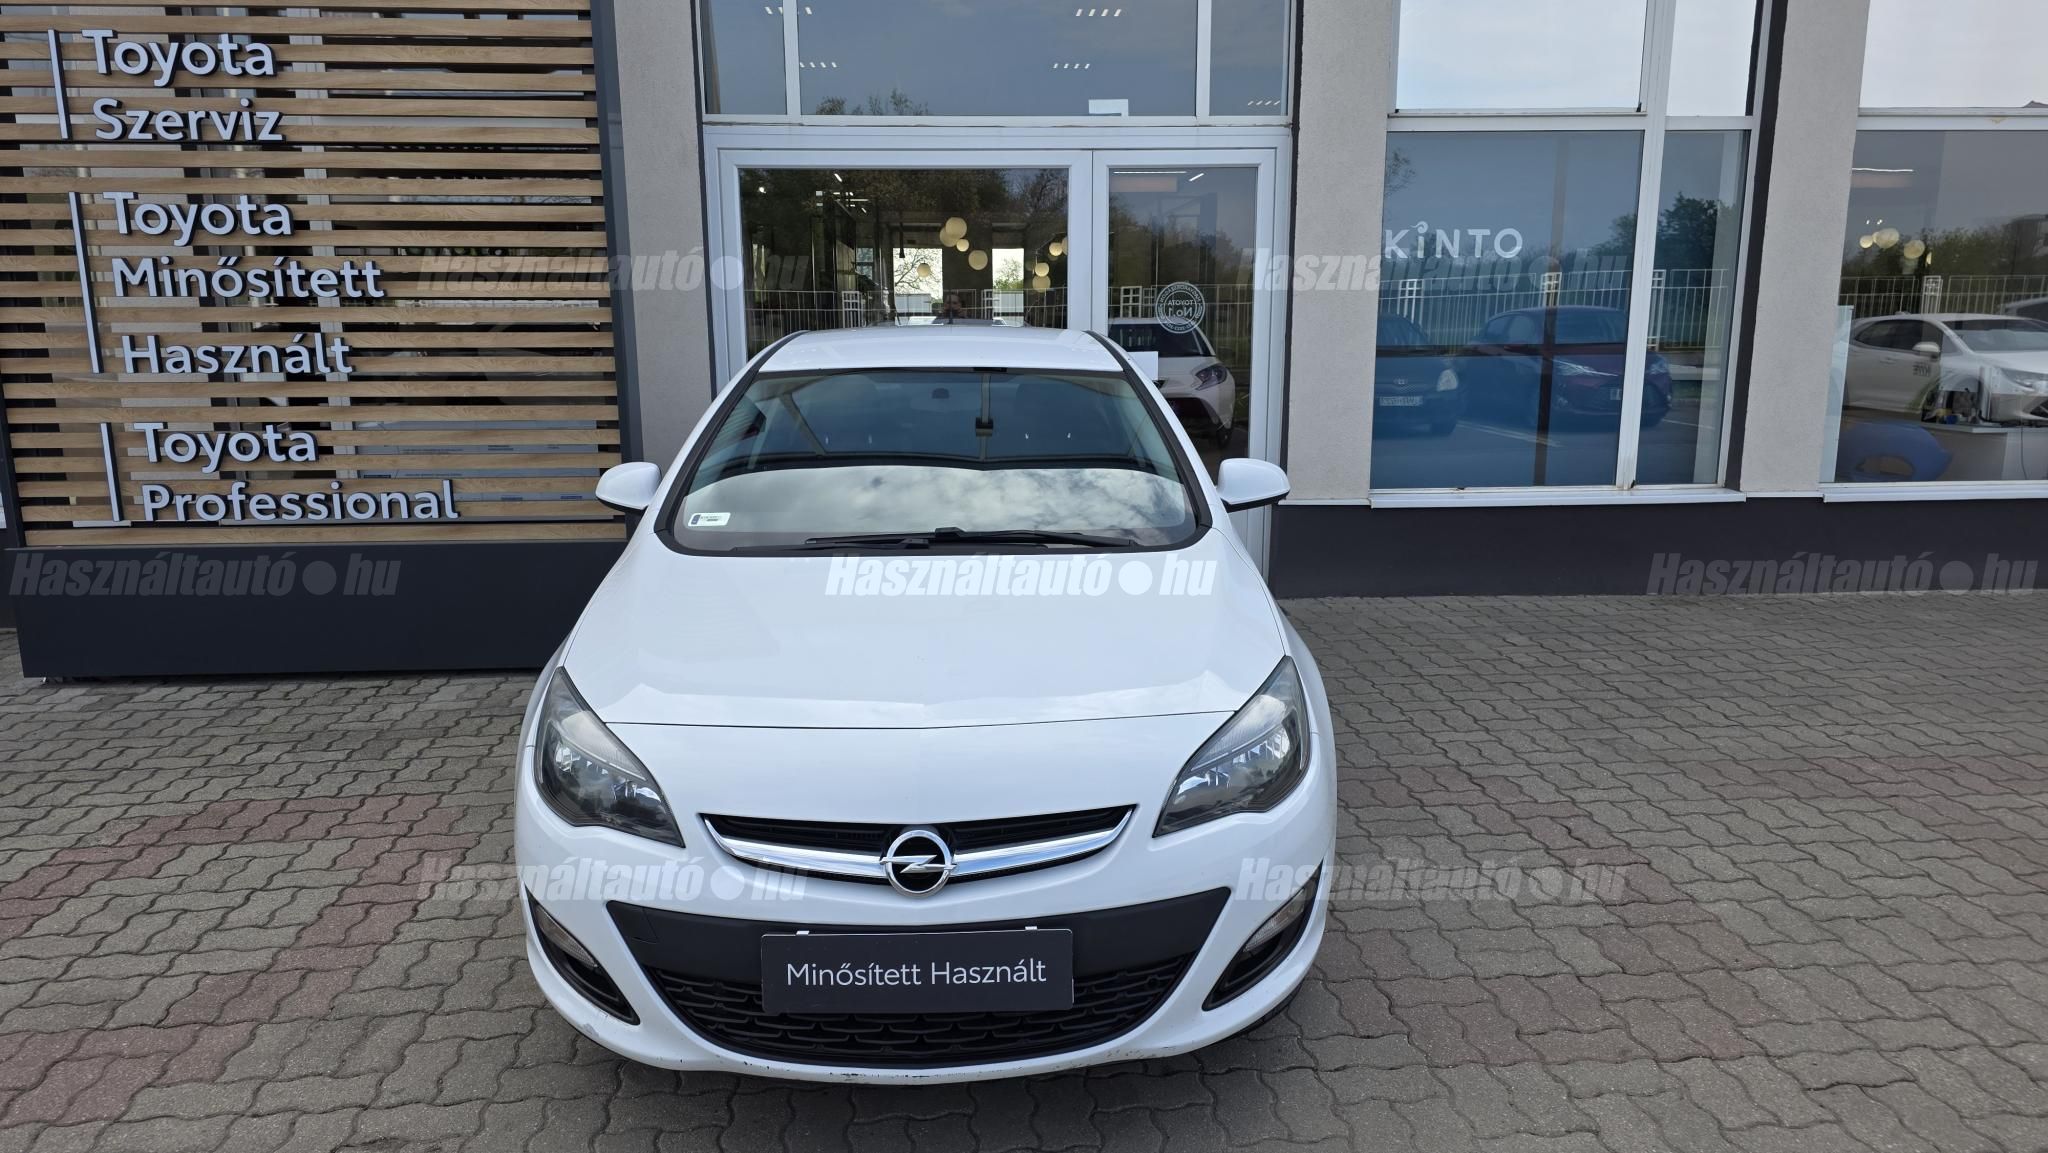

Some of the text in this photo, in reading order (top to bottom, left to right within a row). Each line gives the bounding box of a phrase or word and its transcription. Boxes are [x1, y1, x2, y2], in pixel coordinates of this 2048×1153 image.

[81, 29, 276, 87] Toyota
[92, 97, 285, 141] Szerviz
[102, 191, 294, 246] Toyota
[111, 255, 385, 298] Minősített
[121, 332, 353, 374] Használt
[133, 422, 319, 474] Toyota
[141, 479, 460, 522] Professional
[786, 957, 1047, 986] Minősített Használt
